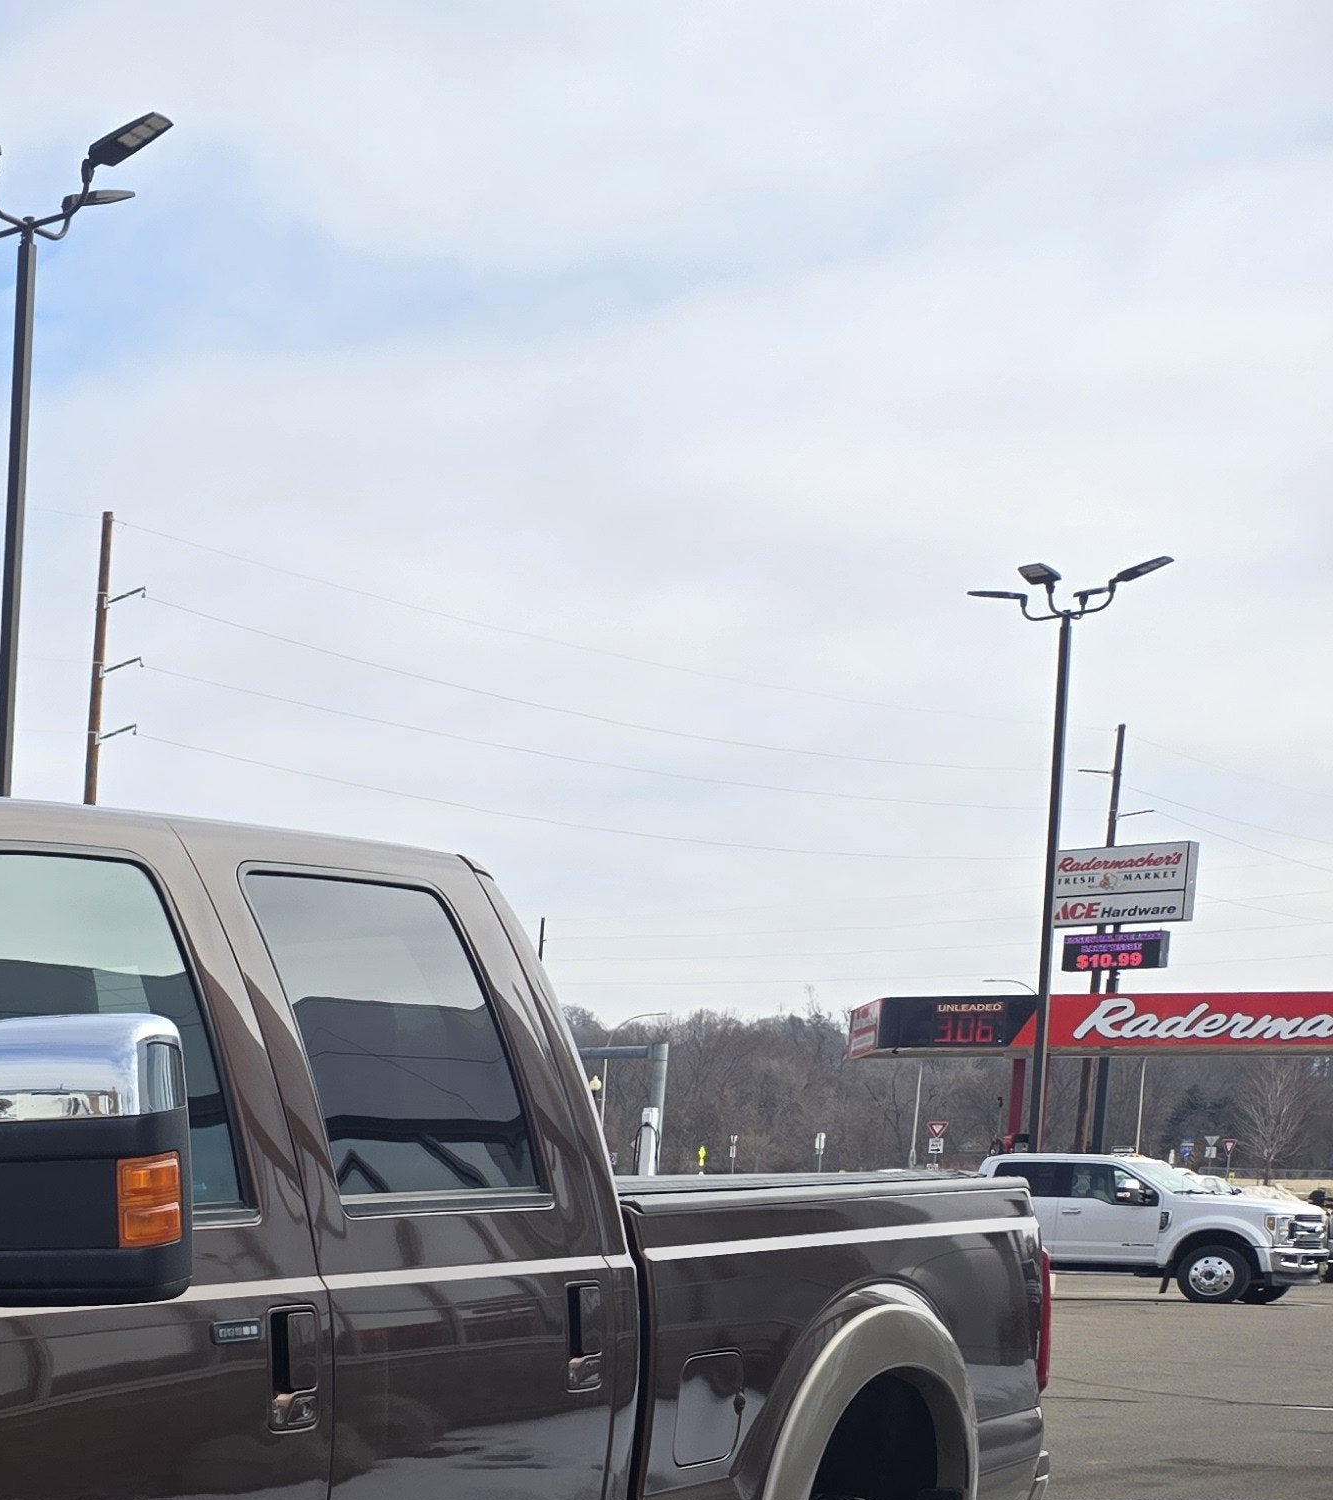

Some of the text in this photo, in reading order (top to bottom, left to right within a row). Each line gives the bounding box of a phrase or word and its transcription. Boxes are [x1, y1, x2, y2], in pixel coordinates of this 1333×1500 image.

[1058, 852, 1182, 873] Radermacher's
[1058, 870, 1177, 885] FRESH MARKET
[1054, 901, 1177, 920] ACE Hardware
[1076, 951, 1142, 969] $10.99
[938, 1003, 1002, 1012] UNLEADED
